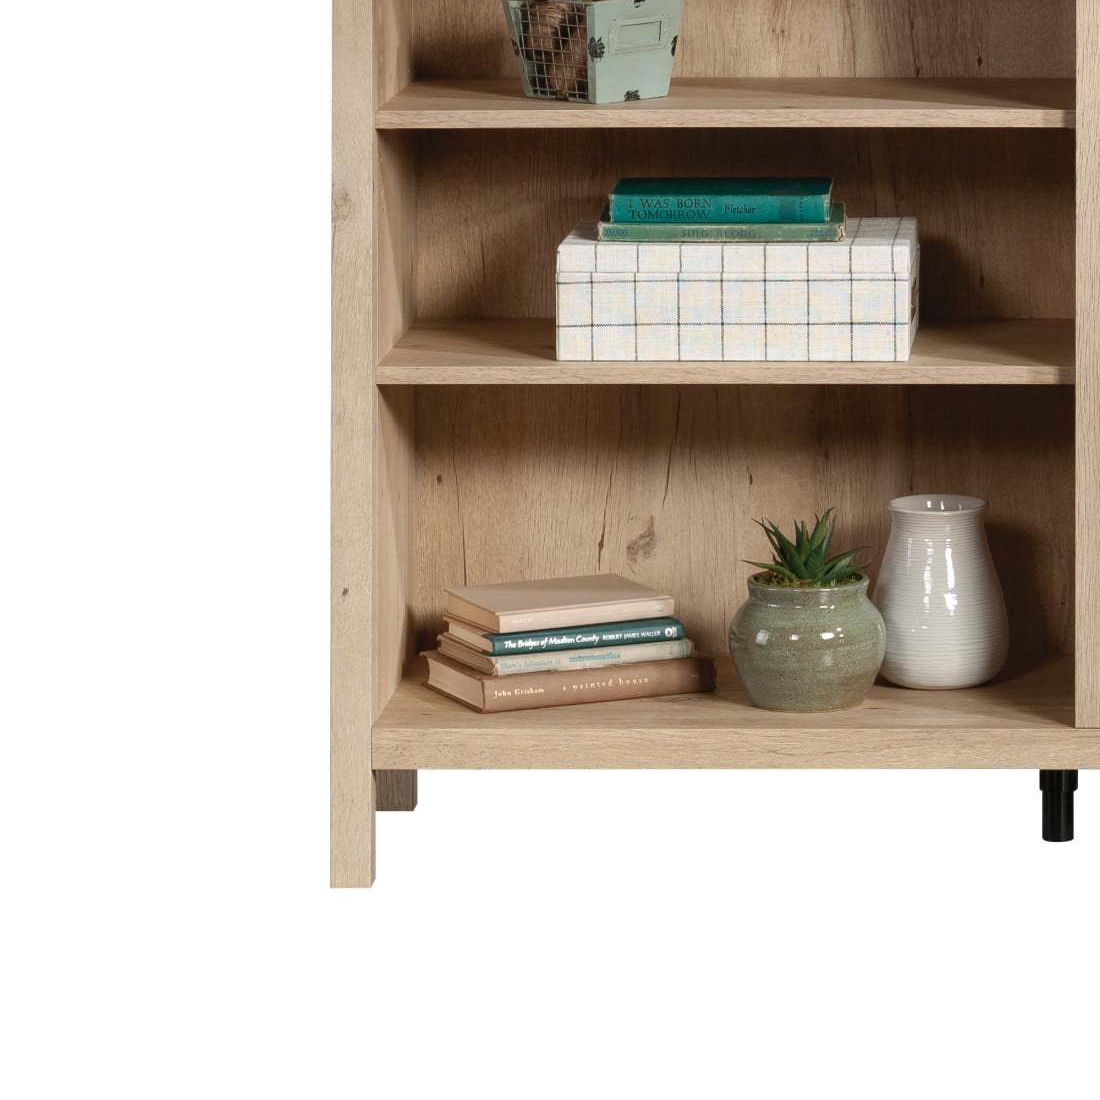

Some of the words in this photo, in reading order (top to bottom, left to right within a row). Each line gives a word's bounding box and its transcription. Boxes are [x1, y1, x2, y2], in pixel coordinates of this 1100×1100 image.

[628, 199, 633, 208] I
[639, 198, 670, 209] WAS
[677, 198, 712, 209] BORN
[723, 204, 757, 214] Fletcher
[628, 209, 712, 220] TOMORROW
[503, 639, 517, 649] The
[540, 636, 548, 649] of
[575, 634, 600, 644] County
[602, 633, 623, 641] ROBERT
[572, 679, 614, 692] painted
[618, 677, 649, 686] house
[493, 690, 512, 699] John
[514, 687, 545, 695] Grisham
